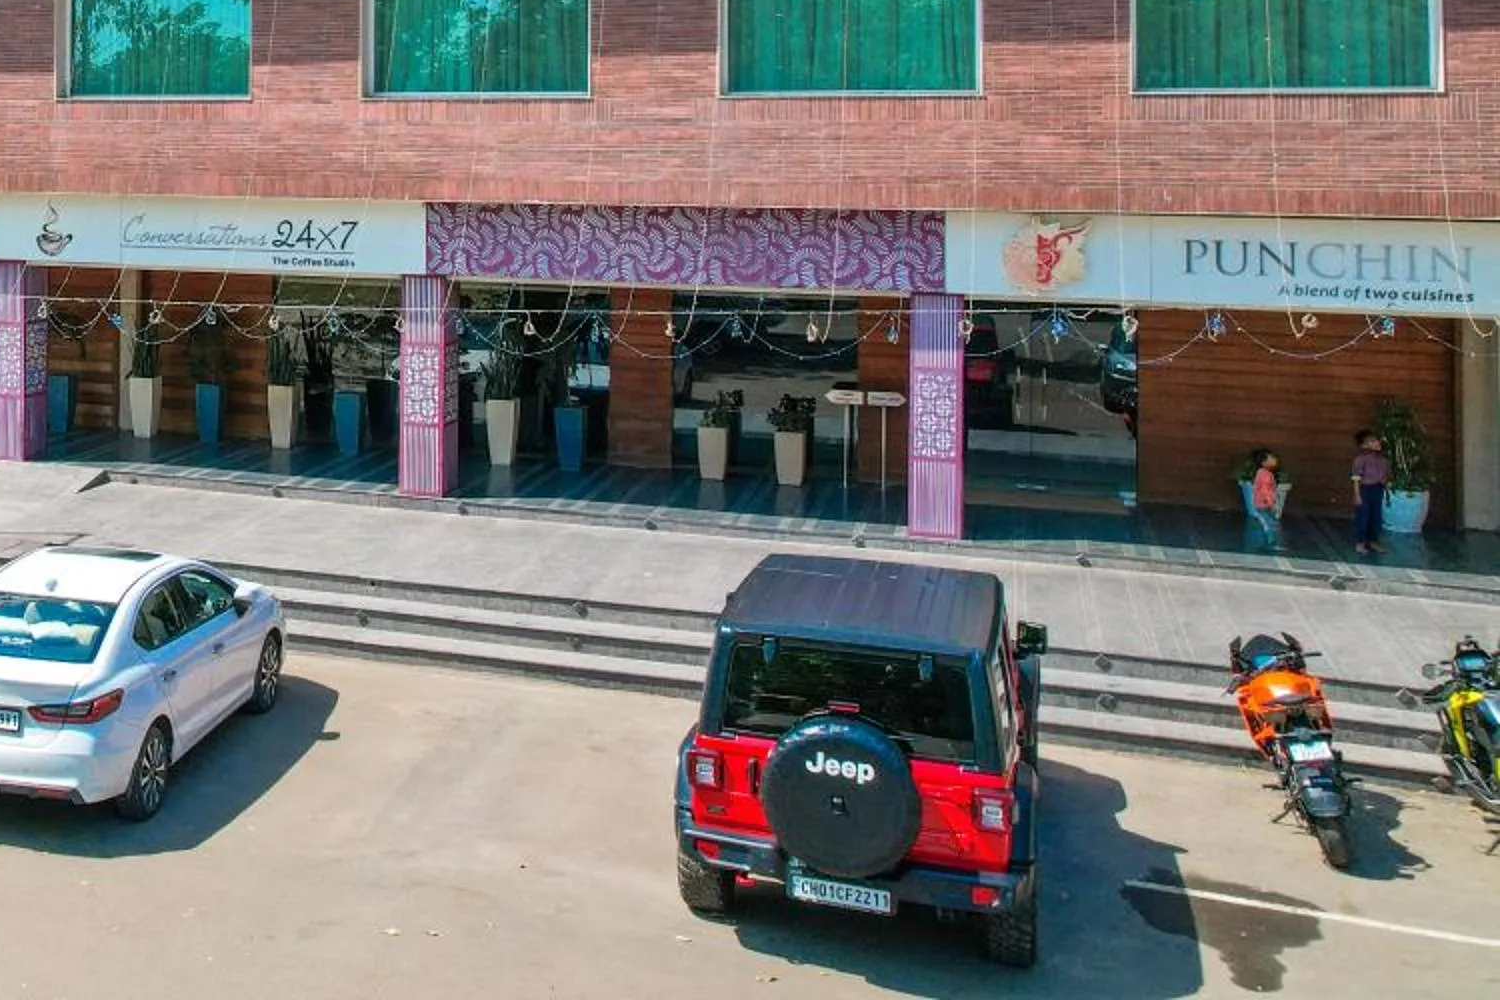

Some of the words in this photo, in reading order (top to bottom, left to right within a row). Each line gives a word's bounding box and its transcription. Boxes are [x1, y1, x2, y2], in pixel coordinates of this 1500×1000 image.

[122, 212, 269, 246] Conversations
[272, 256, 289, 265] The
[291, 256, 322, 267] Coffee
[1183, 238, 1475, 283] PUNCHIN
[1295, 283, 1339, 299] blend
[1343, 285, 1360, 301] of
[1364, 287, 1399, 301] two
[1402, 287, 1475, 303] cuisines
[805, 751, 875, 785] Jeep
[801, 881, 889, 908] CH01CF2211
